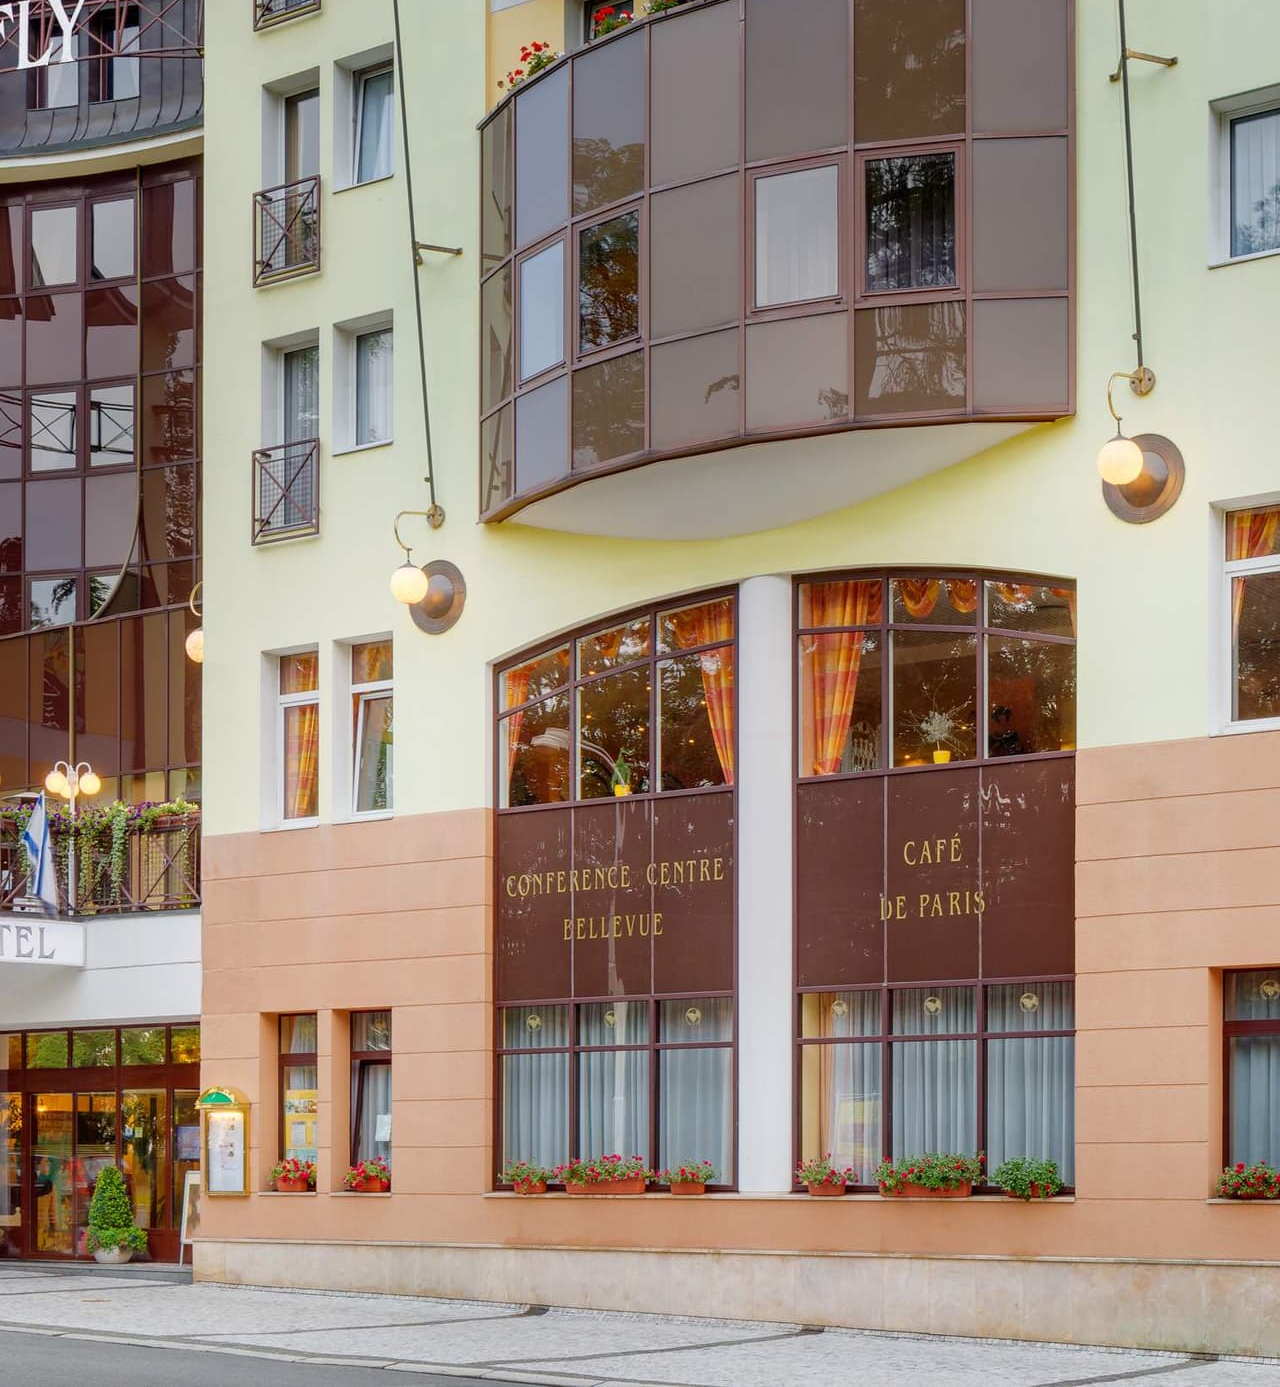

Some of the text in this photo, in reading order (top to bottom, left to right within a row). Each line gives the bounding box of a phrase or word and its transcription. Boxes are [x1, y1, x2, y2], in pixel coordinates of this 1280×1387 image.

[903, 832, 962, 866] CAFÉ
[506, 858, 725, 897] CONFERENCE CENTRE
[880, 891, 986, 921] DE PARIS
[563, 913, 664, 941] BELLEVUE
